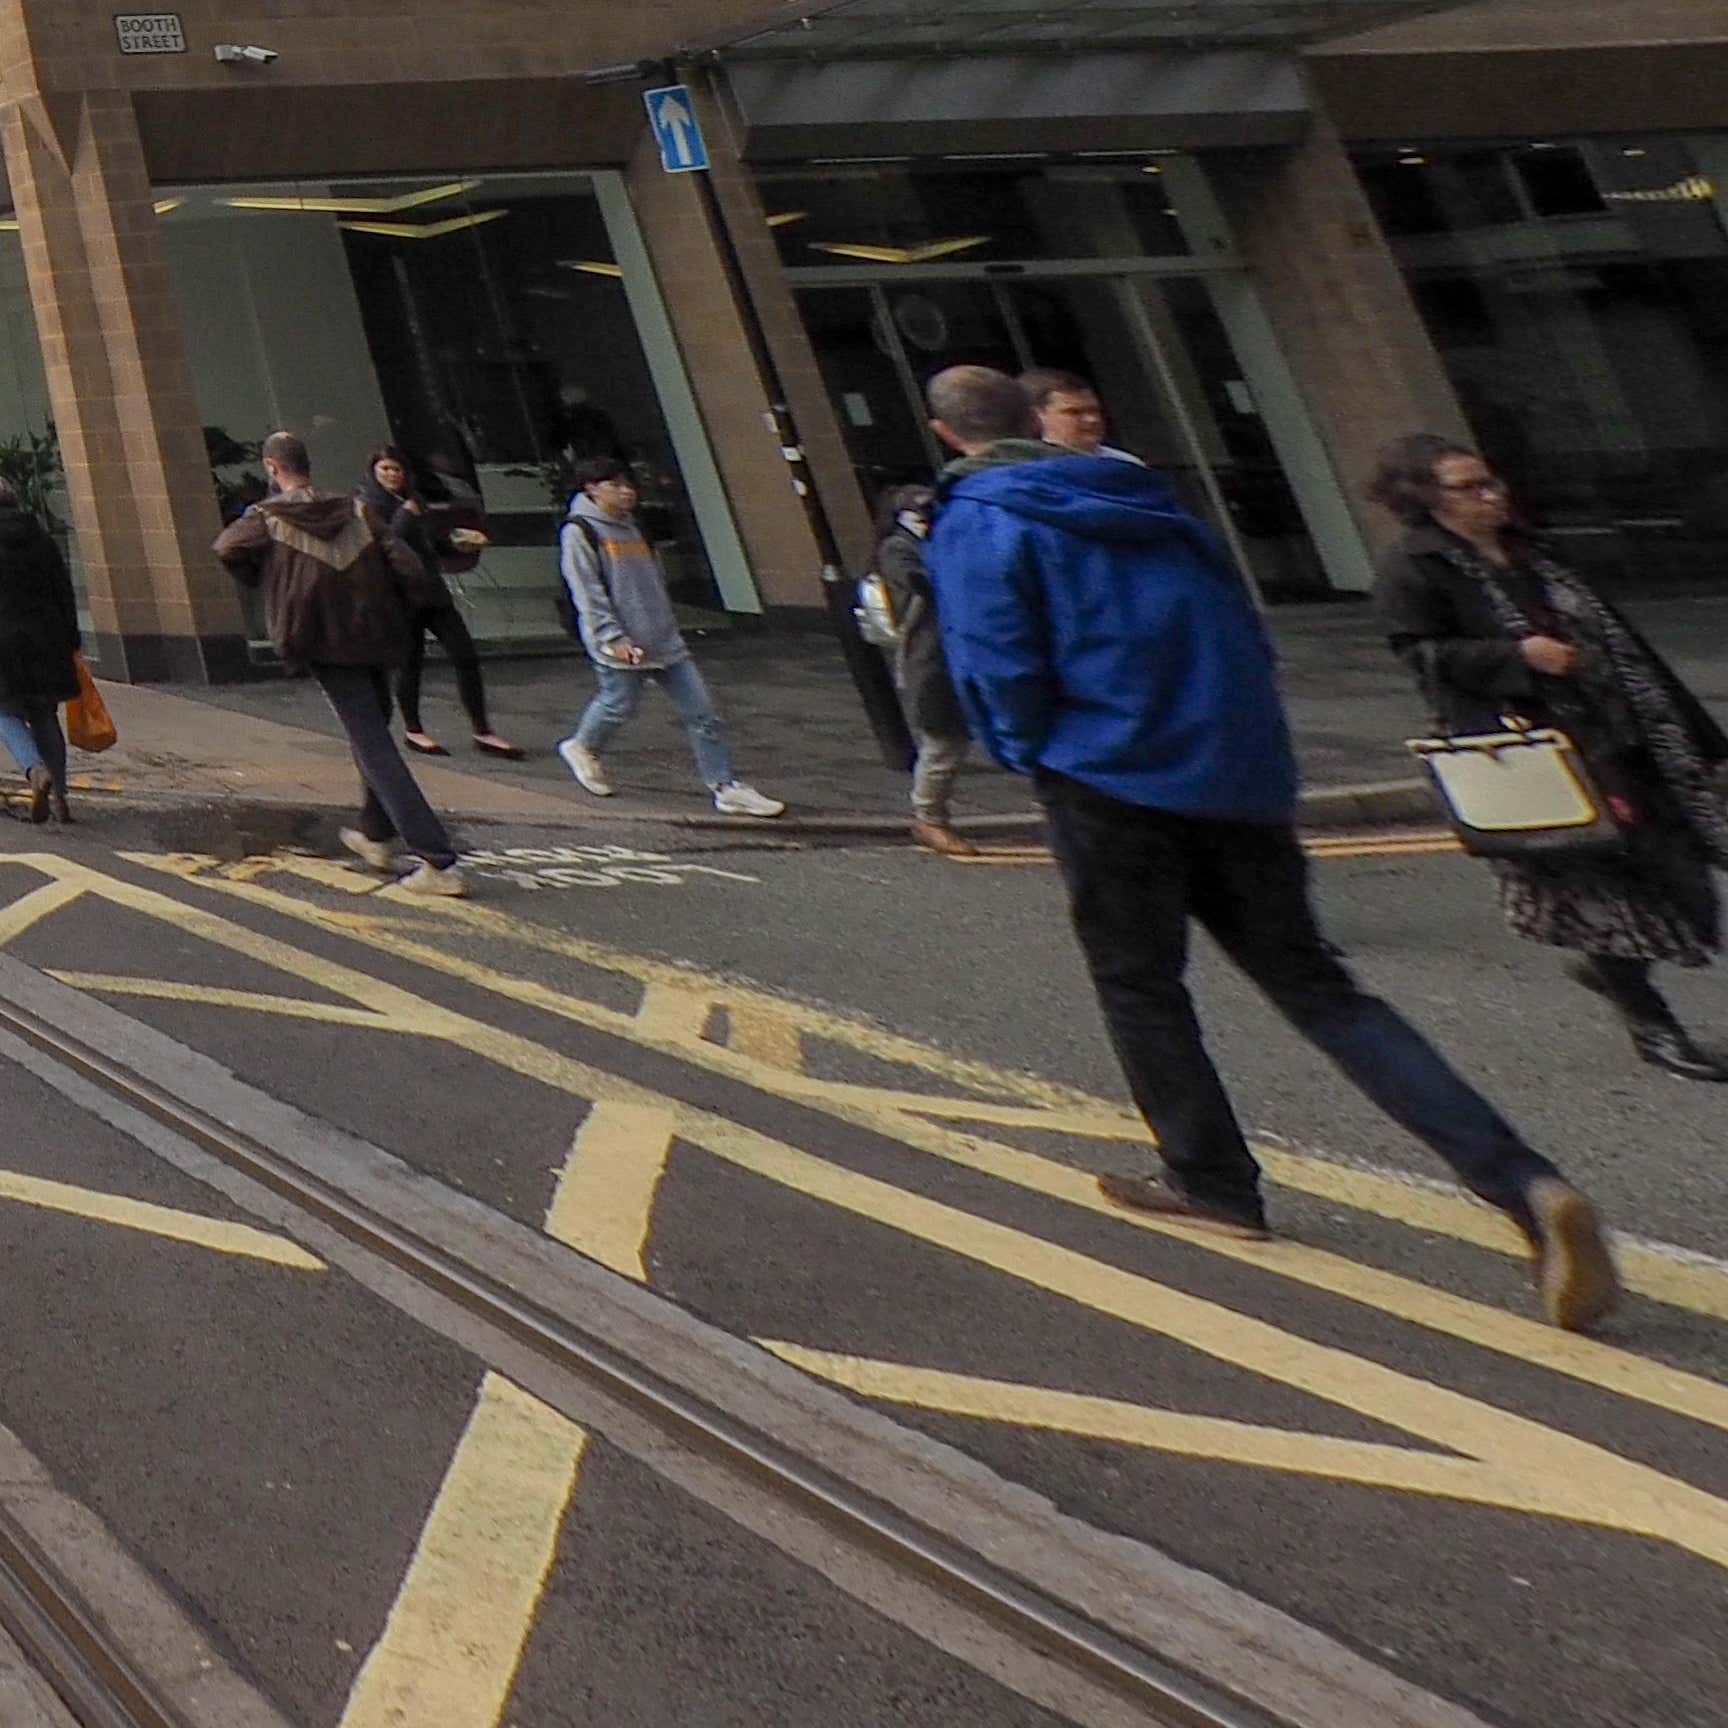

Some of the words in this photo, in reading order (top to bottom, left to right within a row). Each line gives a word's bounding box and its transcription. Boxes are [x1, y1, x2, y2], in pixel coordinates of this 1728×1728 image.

[120, 18, 177, 32] BOOTH
[122, 35, 180, 49] STREET
[478, 864, 763, 890] LOOK
